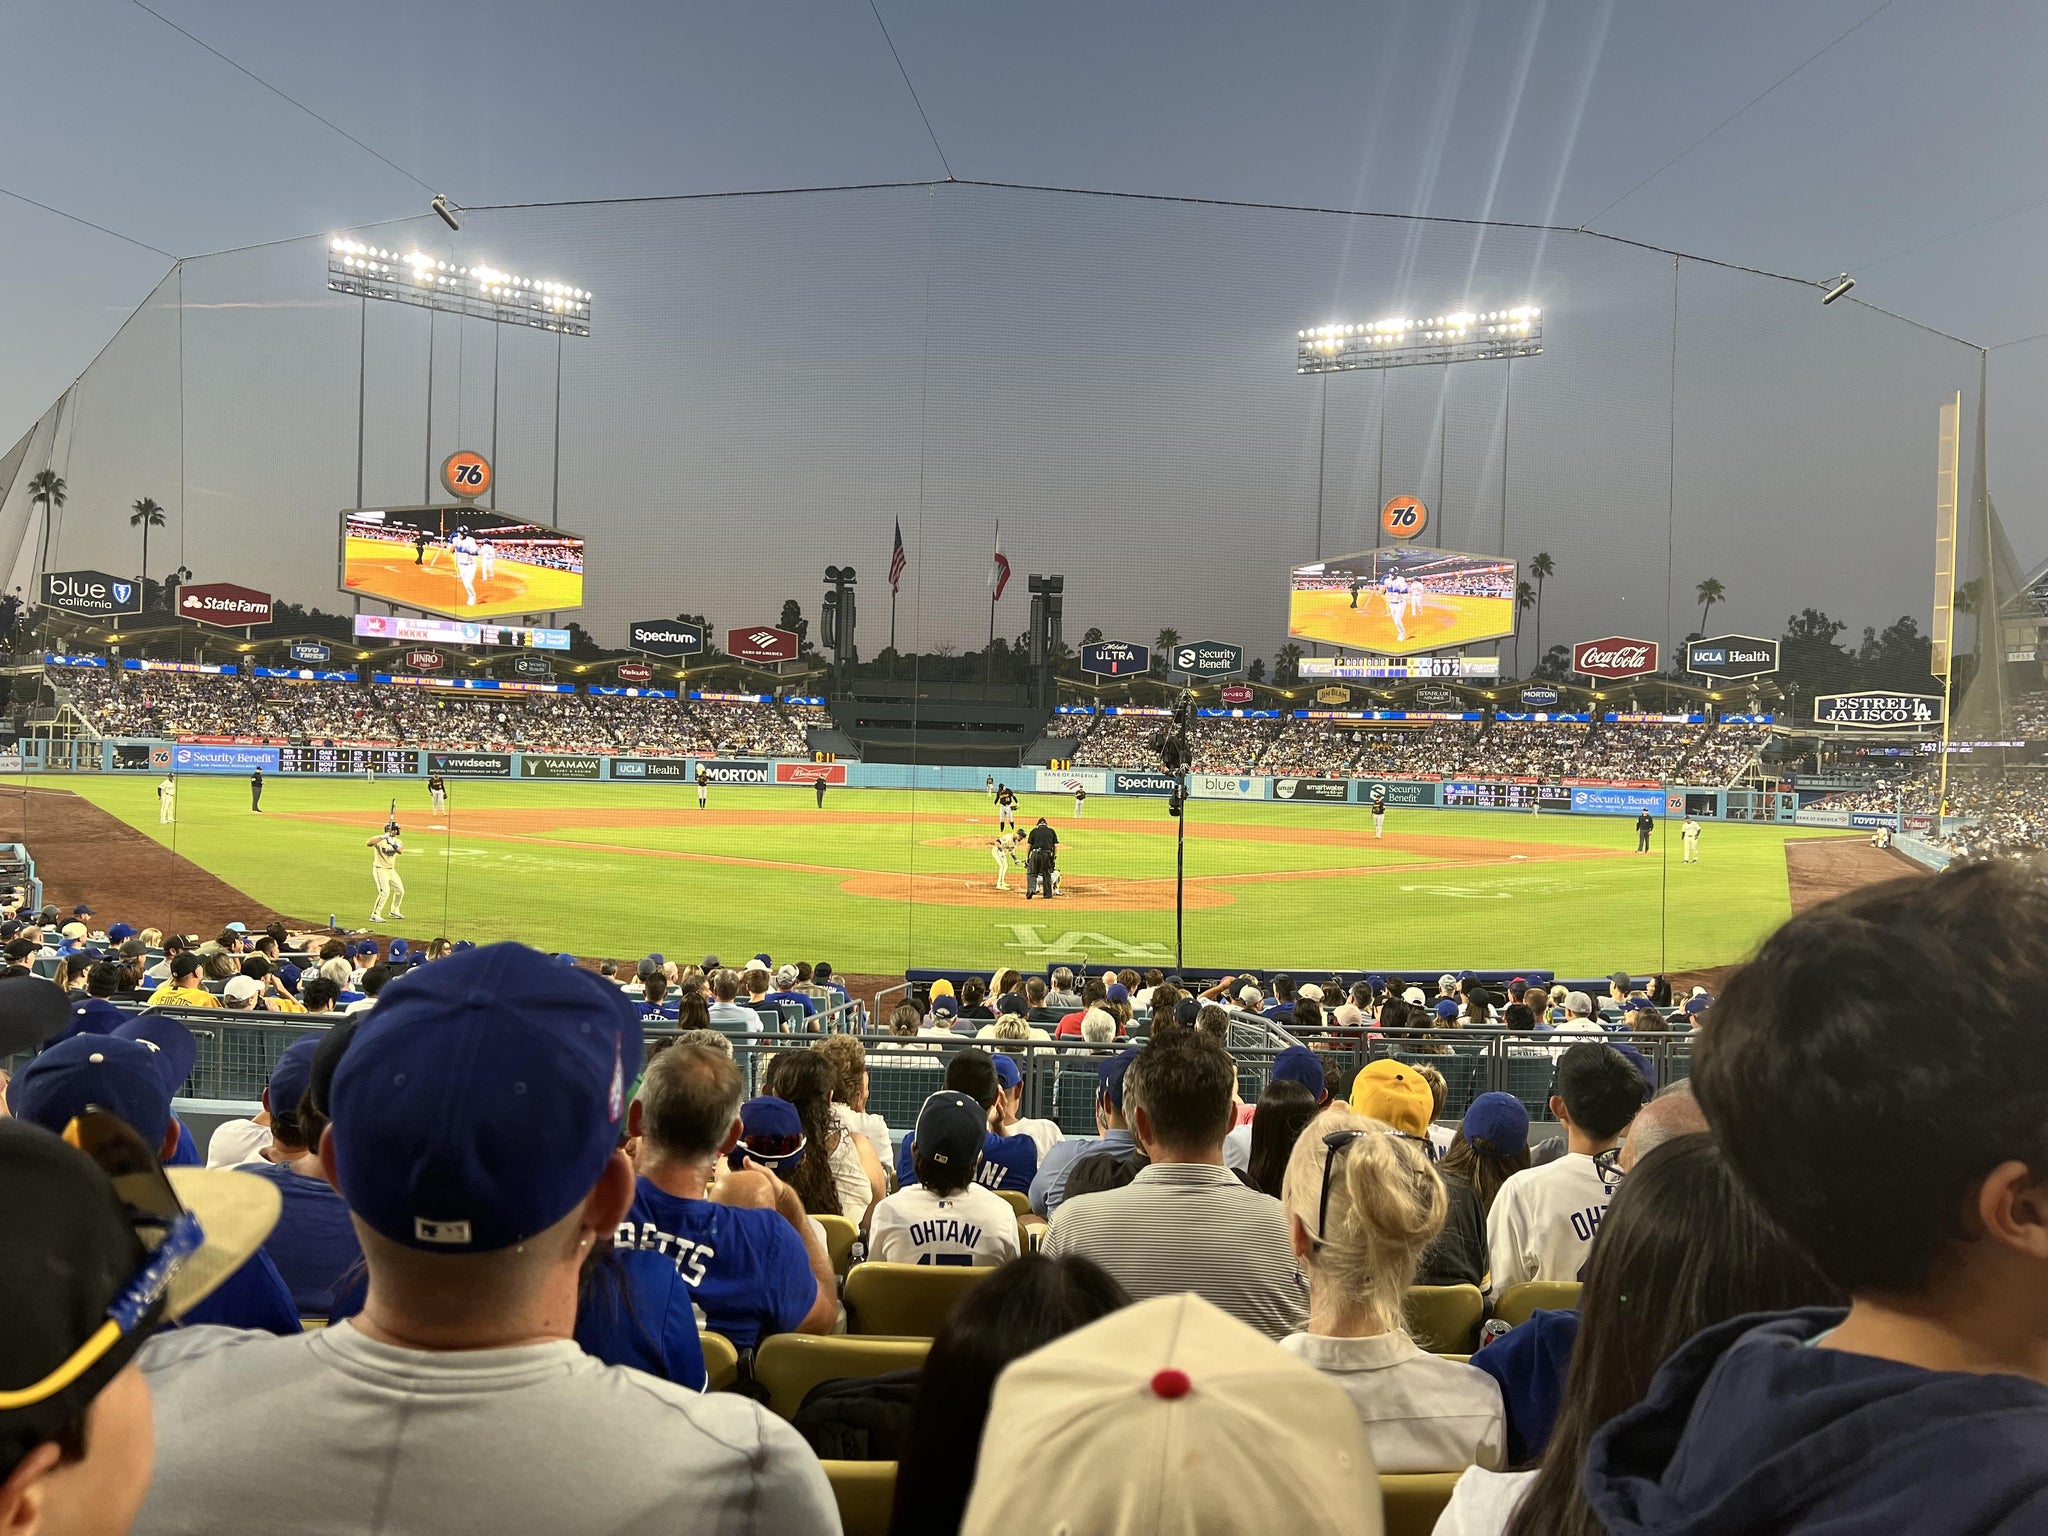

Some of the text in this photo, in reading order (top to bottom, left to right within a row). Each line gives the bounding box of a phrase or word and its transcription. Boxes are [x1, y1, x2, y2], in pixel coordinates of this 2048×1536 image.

[455, 464, 482, 485] 76
[1391, 506, 1417, 526] 76
[50, 576, 106, 599] blue
[58, 597, 112, 609] california
[635, 629, 693, 643] Spectrum
[413, 653, 438, 664] JINRO
[1095, 651, 1134, 660] ULTRA
[1199, 649, 1236, 661] Security
[1580, 646, 1649, 669] Coca-Cola
[1694, 650, 1770, 663] UCLA Health
[1199, 659, 1232, 669] Benefit
[1523, 690, 1556, 699] MORTON
[1826, 709, 1908, 721] JALISCO
[1920, 742, 1937, 752] 7:52
[154, 752, 169, 763] 76
[193, 751, 272, 764] Security Benefit
[448, 758, 502, 768] vividseats
[544, 760, 598, 769] YAAMAVA'
[619, 764, 680, 776] UCLA Health
[706, 768, 768, 782] MORTON
[1117, 776, 1175, 790] Spectrum
[1205, 778, 1236, 791] blue
[1306, 784, 1345, 792] smartwater
[1388, 785, 1422, 795] Security
[1388, 793, 1417, 803] Benefit
[1589, 793, 1660, 806] Security Benefit
[1669, 799, 1682, 807] 76
[1853, 815, 1898, 827] TOYO TIRES
[1904, 819, 1932, 828] Yakult
[910, 1220, 982, 1249] OHTANI
